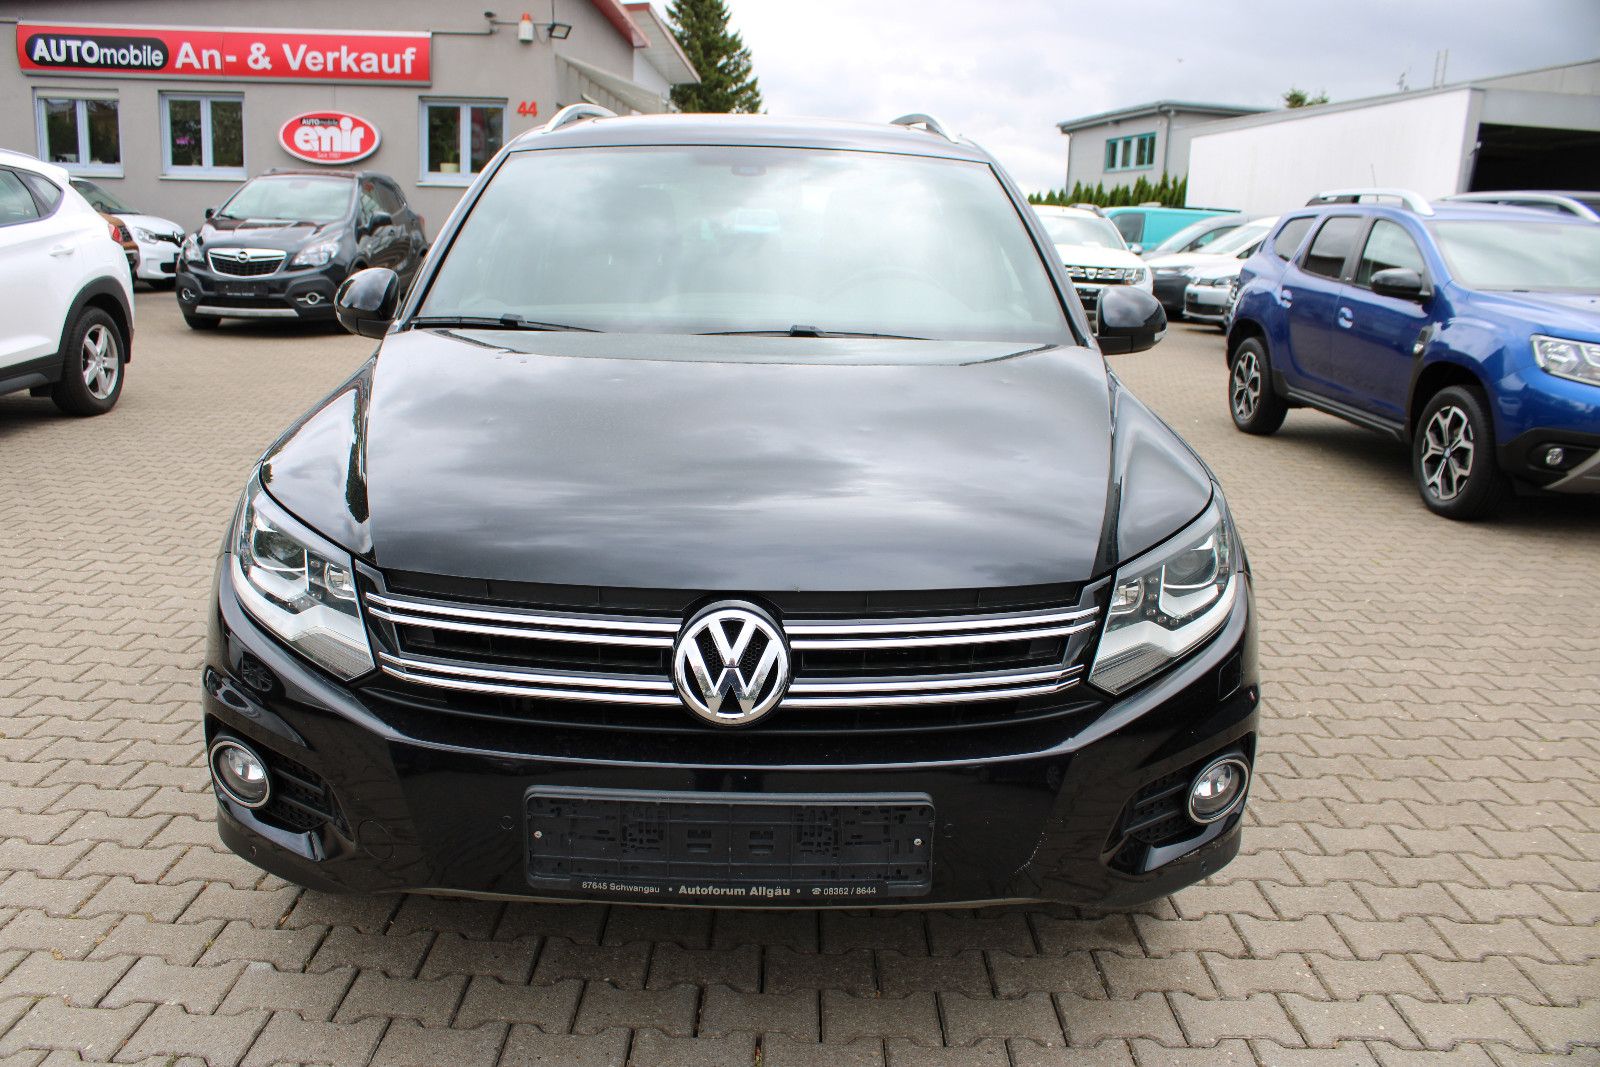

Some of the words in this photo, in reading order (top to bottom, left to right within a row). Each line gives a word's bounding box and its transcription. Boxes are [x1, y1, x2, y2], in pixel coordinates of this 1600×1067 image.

[32, 38, 164, 67] AUTOmobile
[174, 42, 237, 70] An-
[247, 42, 272, 70] &
[282, 43, 417, 74] Verkauf
[517, 101, 537, 117] 44
[294, 117, 364, 152] emir
[582, 881, 608, 890] 87645
[609, 883, 660, 894] Schwangau
[678, 885, 746, 896] Autoforum
[749, 885, 791, 897] Allgäu
[823, 887, 849, 895] 08362
[856, 887, 877, 895] 8644
